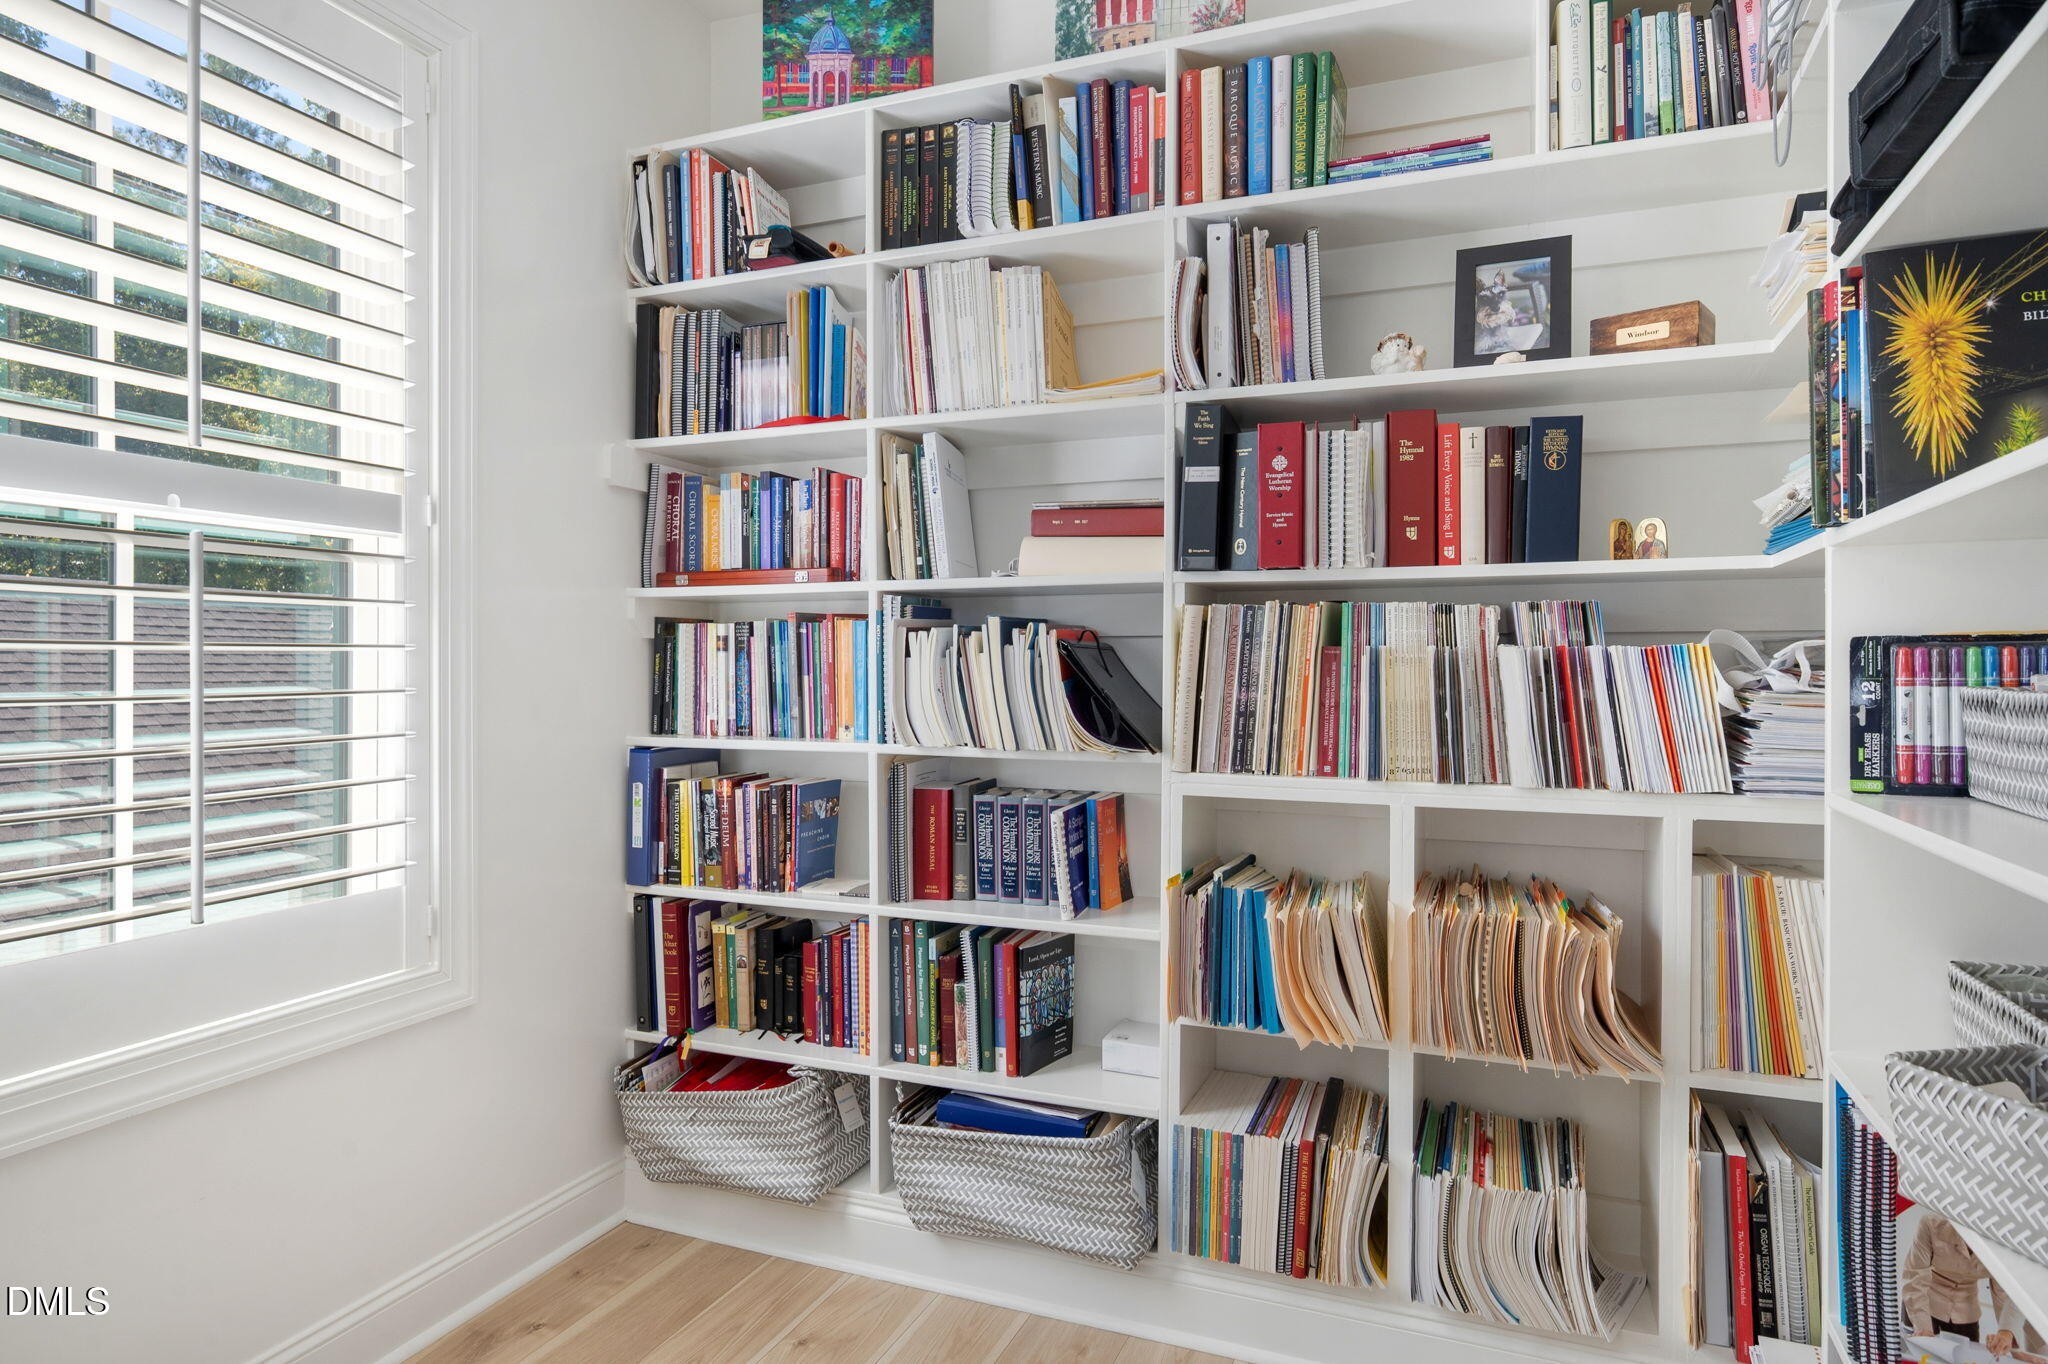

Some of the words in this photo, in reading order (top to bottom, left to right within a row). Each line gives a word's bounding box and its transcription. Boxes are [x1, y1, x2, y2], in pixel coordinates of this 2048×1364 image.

[1696, 22, 1705, 43] david
[1729, 27, 1738, 50] AWAKE
[1698, 45, 1707, 71] sedaris
[1748, 43, 1759, 65] ROYAL
[1733, 67, 1742, 86] WOKE
[1751, 68, 1760, 83] BLUE
[1185, 96, 1195, 144] MEDIEVAL
[1228, 80, 1238, 138] BAROQUE
[1254, 85, 1266, 140] CLASSICAL
[1295, 84, 1306, 151] TWENTIETH-CENTURY
[1318, 100, 1326, 155] TWENTIETH-CENTURY
[1030, 129, 1040, 170] WESTERN
[1254, 142, 1266, 176] MUSIC
[1230, 145, 1239, 185] MUSIC
[1295, 153, 1305, 174] MUSIC
[1316, 156, 1324, 172] MUSIC
[1034, 172, 1043, 200] MUSIC
[2020, 290, 2048, 303] CH
[2022, 310, 2048, 321] BIL
[1626, 327, 1660, 338] Windsor
[1400, 446, 1424, 454] Hymnal
[1444, 434, 1452, 448] Lift
[1443, 450, 1452, 472] Every
[1445, 497, 1453, 512] and
[1443, 513, 1453, 530] Sing
[1229, 624, 1239, 671] NOCTURNES
[1242, 638, 1250, 667] COMPLETE
[1252, 638, 1260, 666] COMPLETE
[1862, 681, 1875, 700] 12
[1224, 692, 1232, 737] POLONAISES
[1872, 733, 1880, 777] MARKERS
[710, 808, 718, 829] Sacred
[722, 804, 729, 815] TE
[674, 823, 679, 832] OF
[1034, 817, 1042, 828] The
[711, 830, 719, 849] Music
[984, 826, 993, 847] Hymnal
[1010, 828, 1018, 850] Hymnal
[1034, 828, 1042, 851] Hymnal
[1778, 897, 1787, 917] BACH:
[1782, 919, 1792, 937] BASIC
[1786, 938, 1795, 959] ORGAN
[1795, 996, 1805, 1021] Faulkner
[1299, 1192, 1307, 1225] ORGANIST
[1760, 1228, 1768, 1254] ORGAN
[1763, 1256, 1772, 1294] TECHNIQUE
